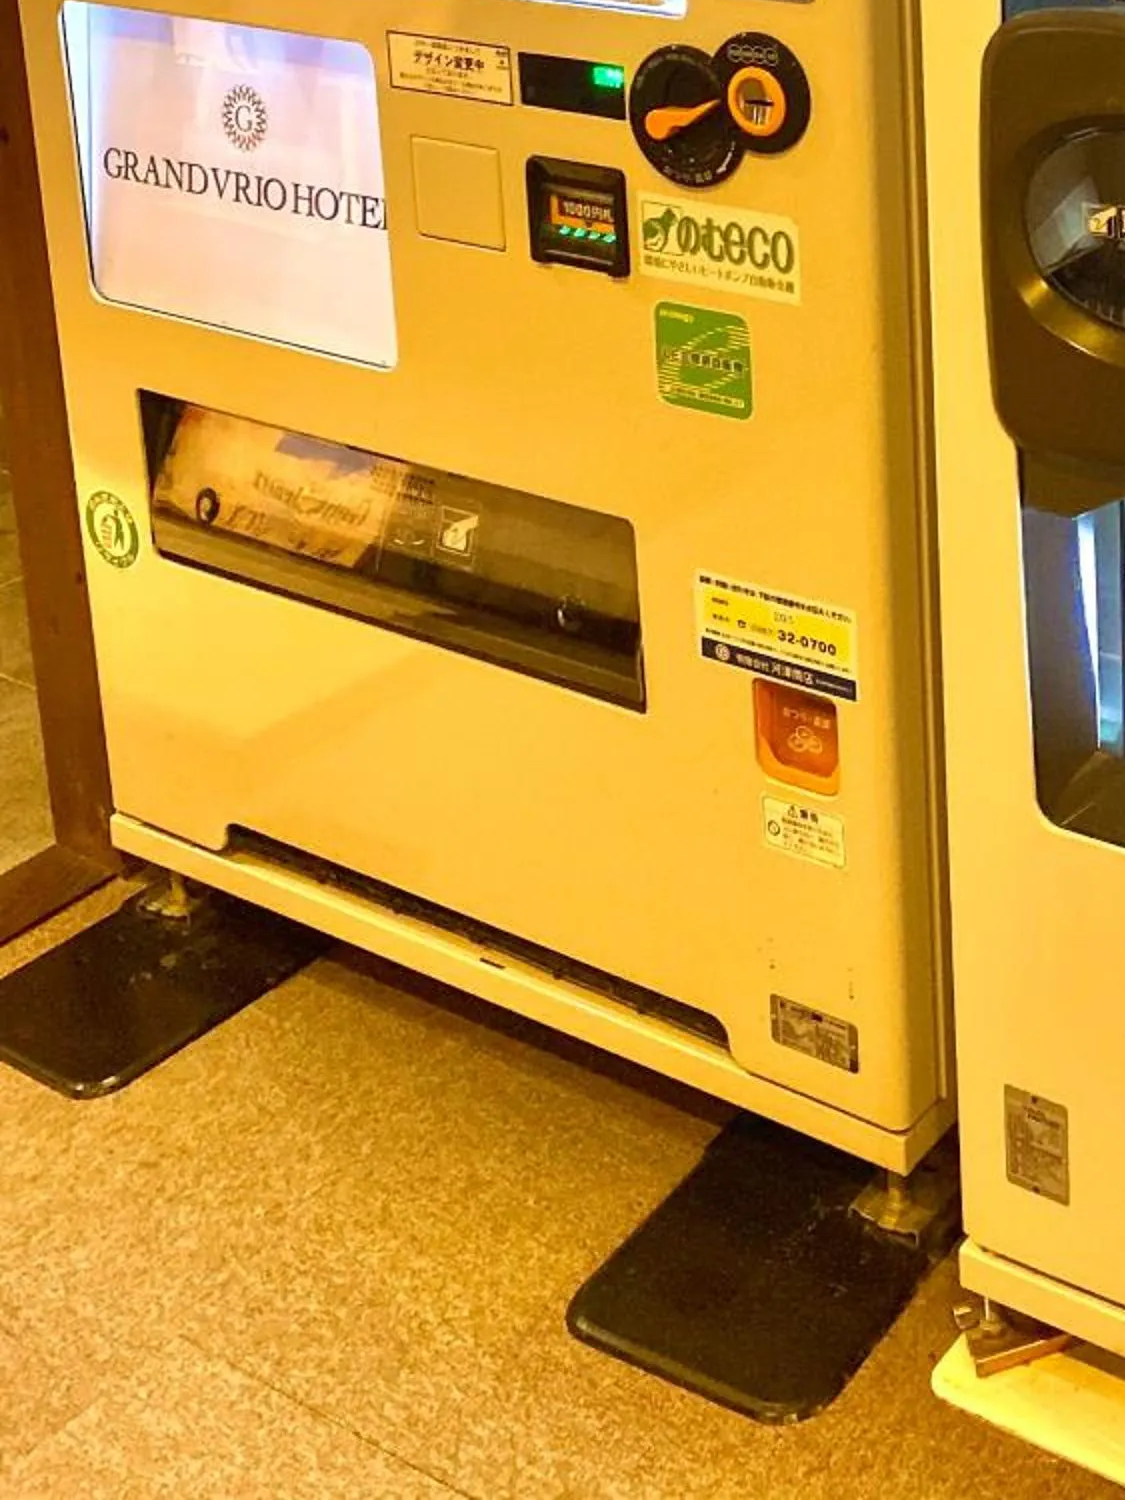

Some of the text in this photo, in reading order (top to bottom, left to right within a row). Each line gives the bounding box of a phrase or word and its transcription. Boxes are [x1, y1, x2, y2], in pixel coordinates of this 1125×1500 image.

[104, 147, 208, 195] GRAND
[211, 166, 287, 211] VRIO
[777, 629, 837, 657] 32-0700
